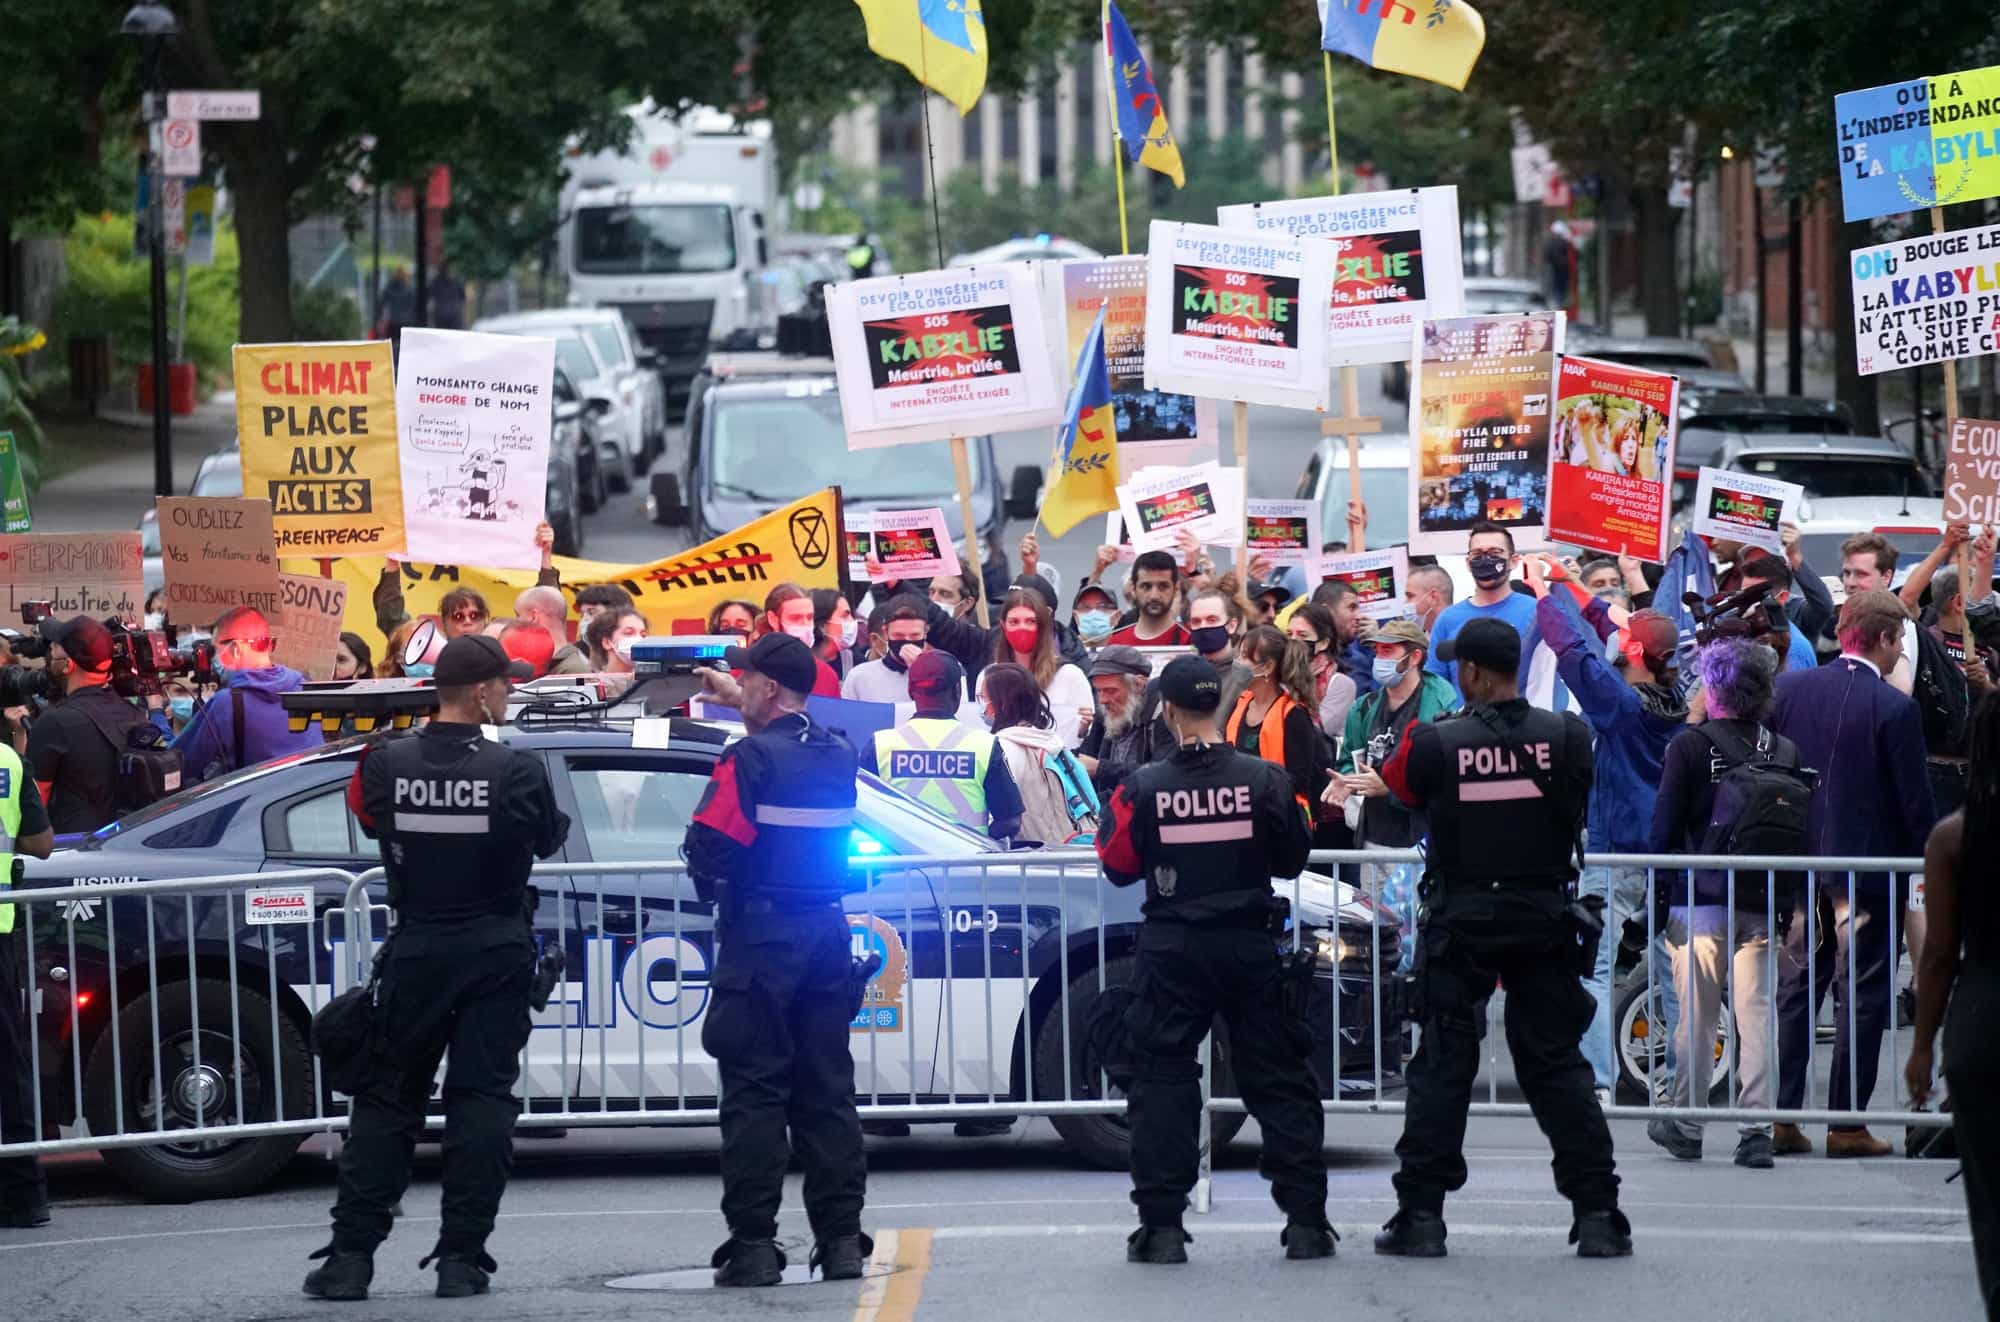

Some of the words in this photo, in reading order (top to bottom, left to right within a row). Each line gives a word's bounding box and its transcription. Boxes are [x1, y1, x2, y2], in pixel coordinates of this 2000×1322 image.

[1896, 83, 1937, 105] OUI
[1842, 142, 1868, 163] DE
[1856, 159, 1885, 179] LA
[1257, 215, 1311, 229] DEVOIR
[1318, 204, 1416, 223] D'INGÉRENCE
[1288, 217, 1387, 234] ÉCOLOGIQUE
[1177, 240, 1218, 253] DEVOIR
[1224, 244, 1302, 262] D'INGÉRENCE
[1338, 240, 1353, 251] OS
[1905, 236, 1969, 262] BOUGE
[1200, 251, 1276, 269] ÉCOLOGIQUE
[1335, 252, 1411, 281] YLIE
[1225, 273, 1247, 286] SOS
[860, 291, 909, 306] DEVOIR
[915, 280, 1006, 299] D'INGÉRENCE
[890, 293, 979, 312] ÉCOLOGIQUE
[1356, 285, 1407, 300] brûlée
[1863, 293, 1889, 312] LA
[1184, 286, 1289, 322] KABYLIE
[924, 315, 949, 328] SOS
[1330, 310, 1369, 320] NQUÊTE
[1376, 315, 1412, 326] EXIGÉE
[1860, 300, 1968, 334] N'ATTEND
[1186, 318, 1242, 338] Meurtrie,
[1245, 324, 1285, 342] brûlée
[880, 327, 1005, 363] KABYLIE
[1216, 344, 1253, 357] ENQUÊTE
[1896, 338, 1969, 364] COMME
[1184, 350, 1255, 366] INTERNATIONALE
[1258, 359, 1285, 369] EXIGÉE
[1563, 363, 1586, 377] MAK
[261, 361, 372, 395] CLIMAT
[888, 364, 954, 383] Meurtrie,
[957, 359, 1003, 374] brûlée
[416, 376, 486, 390] MONSANTO
[491, 382, 539, 395] CHANGE
[926, 384, 970, 396] ENQUÊTE
[1591, 380, 1625, 393] KAMIRA
[419, 393, 467, 406] ENCORE
[475, 397, 490, 408] DE
[500, 399, 530, 411] NOM
[890, 393, 974, 409] INTERNATIONALE
[978, 387, 1009, 399] EXIGÉE
[262, 405, 368, 437] PLACE
[1493, 425, 1531, 435] UNDER
[1463, 438, 1487, 448] FIRE
[289, 446, 357, 476] AUX
[1476, 453, 1485, 461] ET
[1585, 471, 1622, 485] KAMIRA
[275, 481, 364, 512] ACTES
[1590, 492, 1625, 506] congrès
[1626, 499, 1659, 512] mondial
[1603, 484, 1648, 500] Présidente
[1648, 493, 1660, 503] du
[172, 507, 244, 529] OUBLIEZ
[1617, 506, 1659, 523] Amazighe
[1716, 498, 1776, 519] KABYLIE
[273, 527, 385, 548] GREENPEACE
[9, 541, 142, 573] FERMONS
[256, 547, 271, 564] de
[653, 545, 767, 592] ALLER
[117, 592, 135, 614] du
[240, 590, 280, 613] VERTE
[896, 753, 970, 776] POLICE
[1458, 743, 1551, 776] POLIE
[394, 777, 489, 807] POLICE
[1156, 785, 1252, 819] POLICE
[252, 897, 305, 907] SIMPLEX
[943, 910, 998, 933] 10-9
